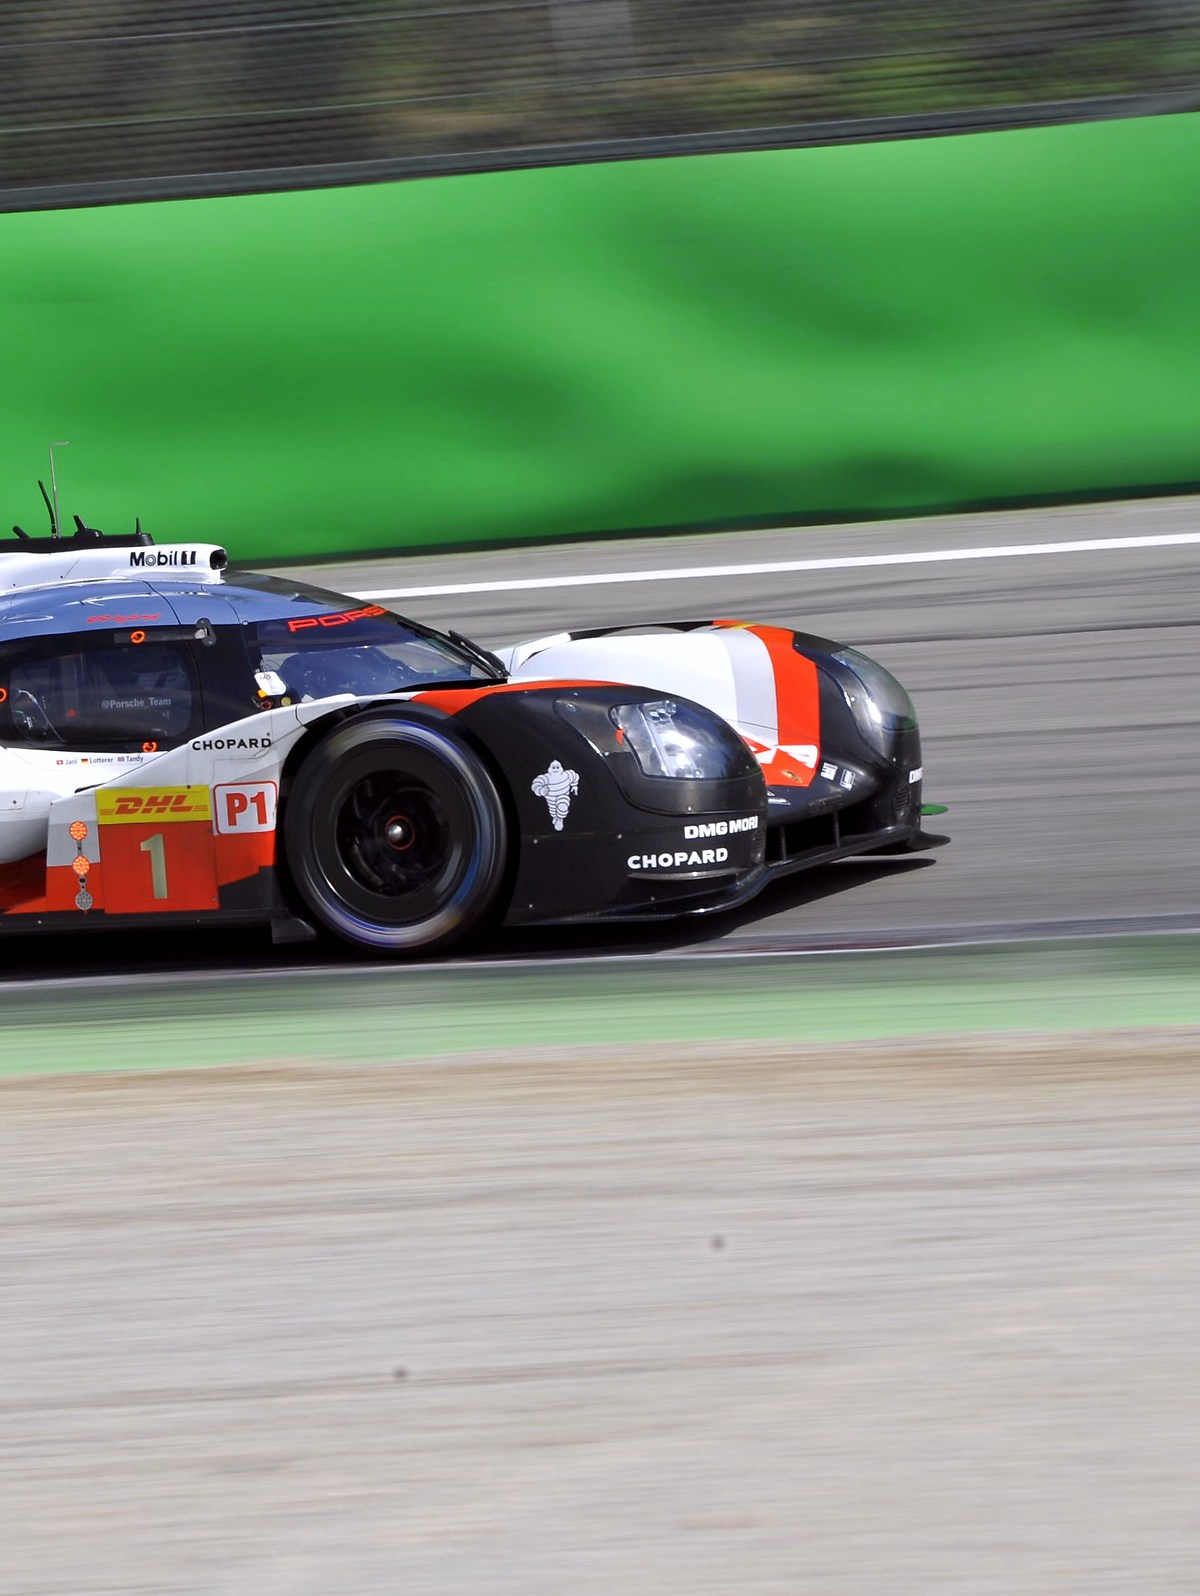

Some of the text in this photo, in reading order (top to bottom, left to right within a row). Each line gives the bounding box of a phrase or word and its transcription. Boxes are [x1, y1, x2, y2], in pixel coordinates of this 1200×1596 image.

[130, 551, 178, 566] Mobil
[101, 697, 172, 710] @Porsche_Team
[192, 737, 272, 751] CHOPARD
[114, 794, 193, 815] DHL
[226, 791, 268, 827] P1
[683, 815, 759, 839] DMG MORI
[140, 833, 168, 899] 1
[627, 847, 729, 869] CHOPARD
